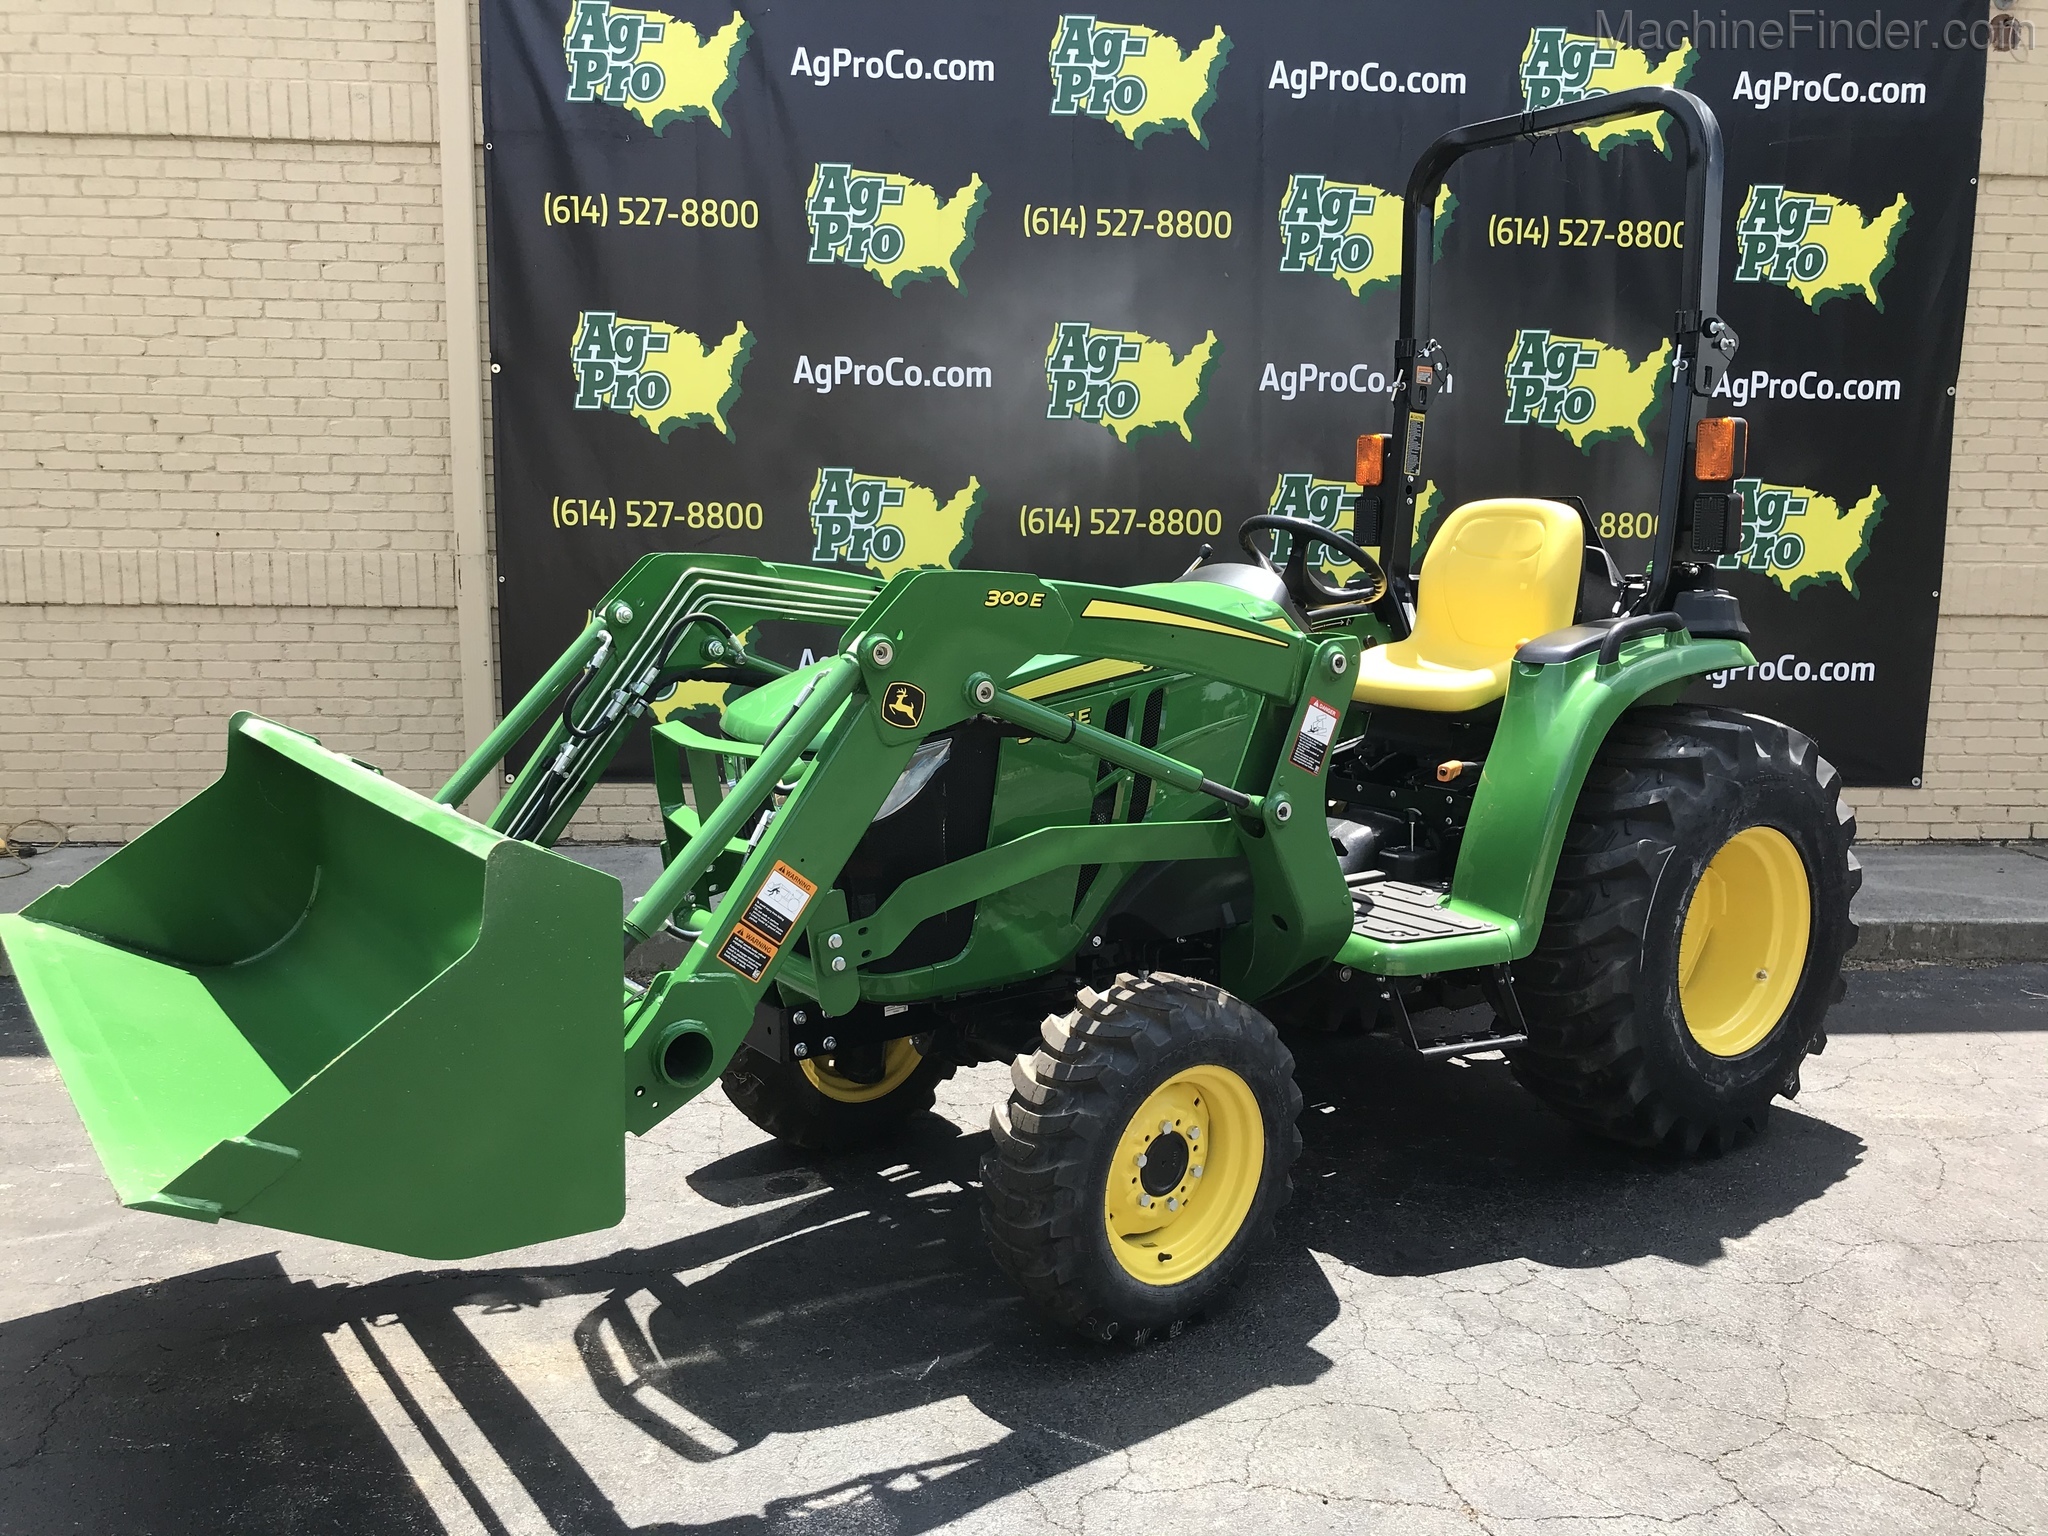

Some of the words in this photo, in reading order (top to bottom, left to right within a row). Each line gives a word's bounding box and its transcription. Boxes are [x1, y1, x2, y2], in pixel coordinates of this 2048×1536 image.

[566, 1, 664, 63] Ag-
[1051, 16, 1147, 76] Ag-
[567, 50, 665, 101] Pro
[791, 47, 995, 87] AgProCo.com
[1051, 64, 1146, 114] Pro
[1269, 61, 1467, 99] AgProCo.com
[1733, 71, 1927, 109] AgProCo.com
[544, 192, 609, 228] (614)
[619, 197, 759, 228] 527-8800
[809, 163, 905, 225] Ag-
[1282, 175, 1374, 232] Ag-
[1739, 185, 1832, 240] Ag-
[808, 213, 905, 262] Pro
[1023, 204, 1087, 239] (614)
[1096, 208, 1232, 239] 527-8800
[1488, 214, 1550, 249] (614)
[1280, 223, 1372, 271] Pro
[1735, 234, 1827, 281] Pro
[574, 312, 669, 370] Ag-
[1047, 323, 1141, 376] Ag-
[1506, 330, 1599, 382] Ag-
[574, 361, 670, 409] Pro
[793, 355, 992, 394] AgProCo.com
[1046, 372, 1140, 418] Pro
[1711, 371, 1901, 407] AgProCo.com
[1505, 376, 1597, 423] Pro
[552, 496, 617, 530] (614)
[626, 500, 763, 530] 527-8800
[814, 468, 904, 524] Ag-
[813, 516, 905, 561] Pro
[1020, 504, 1081, 537] (614)
[1090, 508, 1222, 536] 527-8800
[785, 870, 812, 892] WARNING
[745, 932, 773, 955] WARNING
